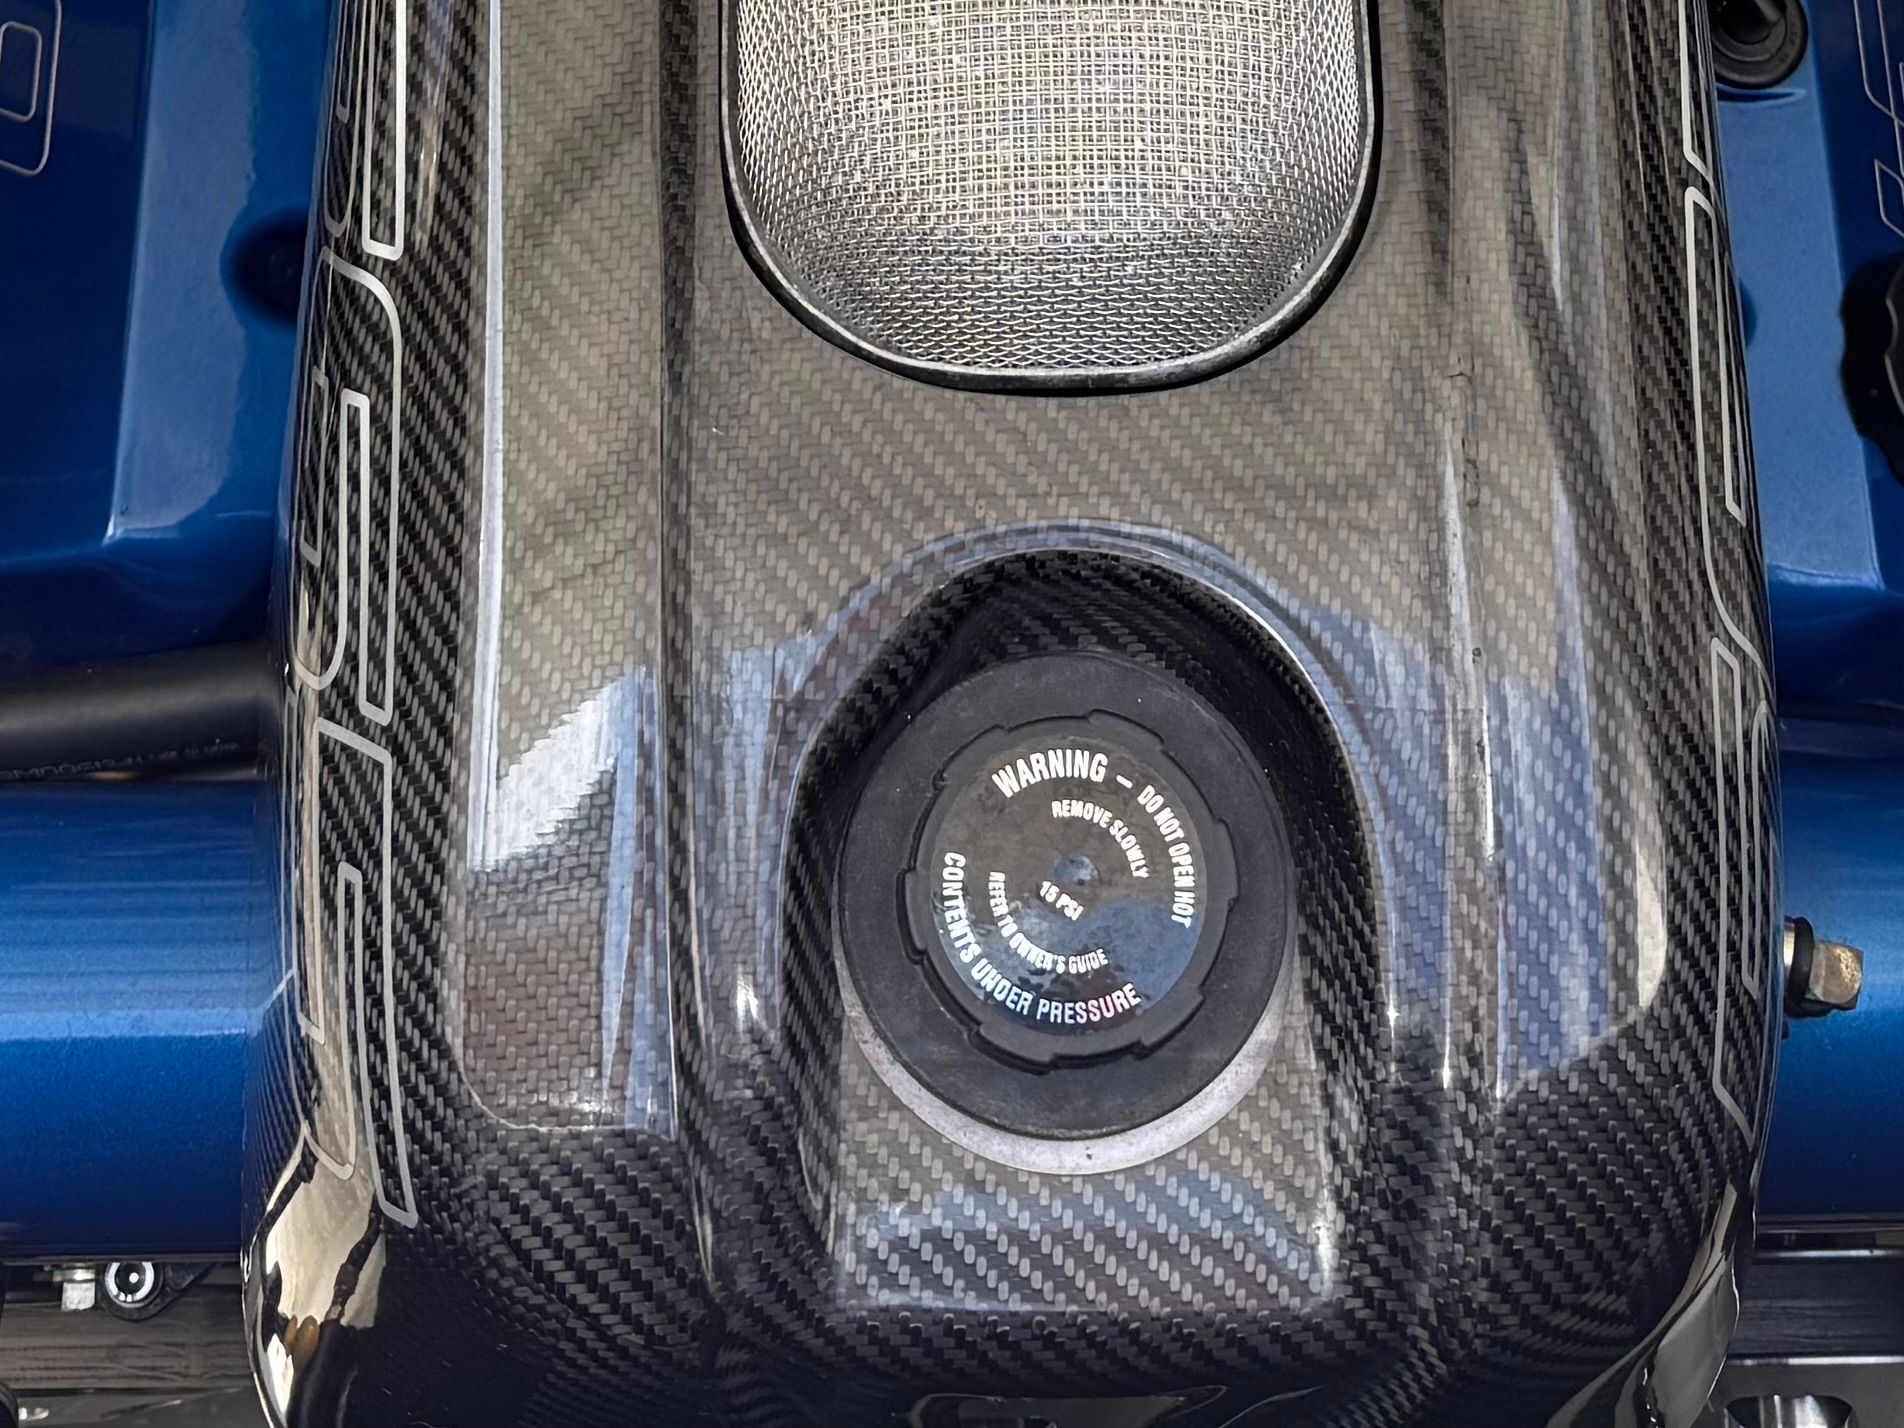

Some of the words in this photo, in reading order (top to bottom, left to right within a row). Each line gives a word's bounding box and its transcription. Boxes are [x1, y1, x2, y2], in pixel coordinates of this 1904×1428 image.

[991, 748, 1109, 798] WARNING
[1136, 784, 1165, 815] DO
[1051, 799, 1113, 829] REMOVE
[1109, 819, 1149, 879] SLOWLY
[1153, 807, 1185, 843] NOT
[1168, 843, 1196, 888] OPEN
[988, 871, 1010, 917] REFER
[1039, 881, 1060, 902] 15
[1055, 892, 1085, 921] PSI
[1171, 891, 1195, 929] HOT
[942, 852, 984, 963] CONTENTS
[970, 957, 1034, 1016] UNDER
[1036, 983, 1142, 1024] PRESSURE
[997, 913, 1018, 938] TO
[1008, 932, 1066, 974] OWNER'S
[1068, 948, 1109, 974] GUIDE
